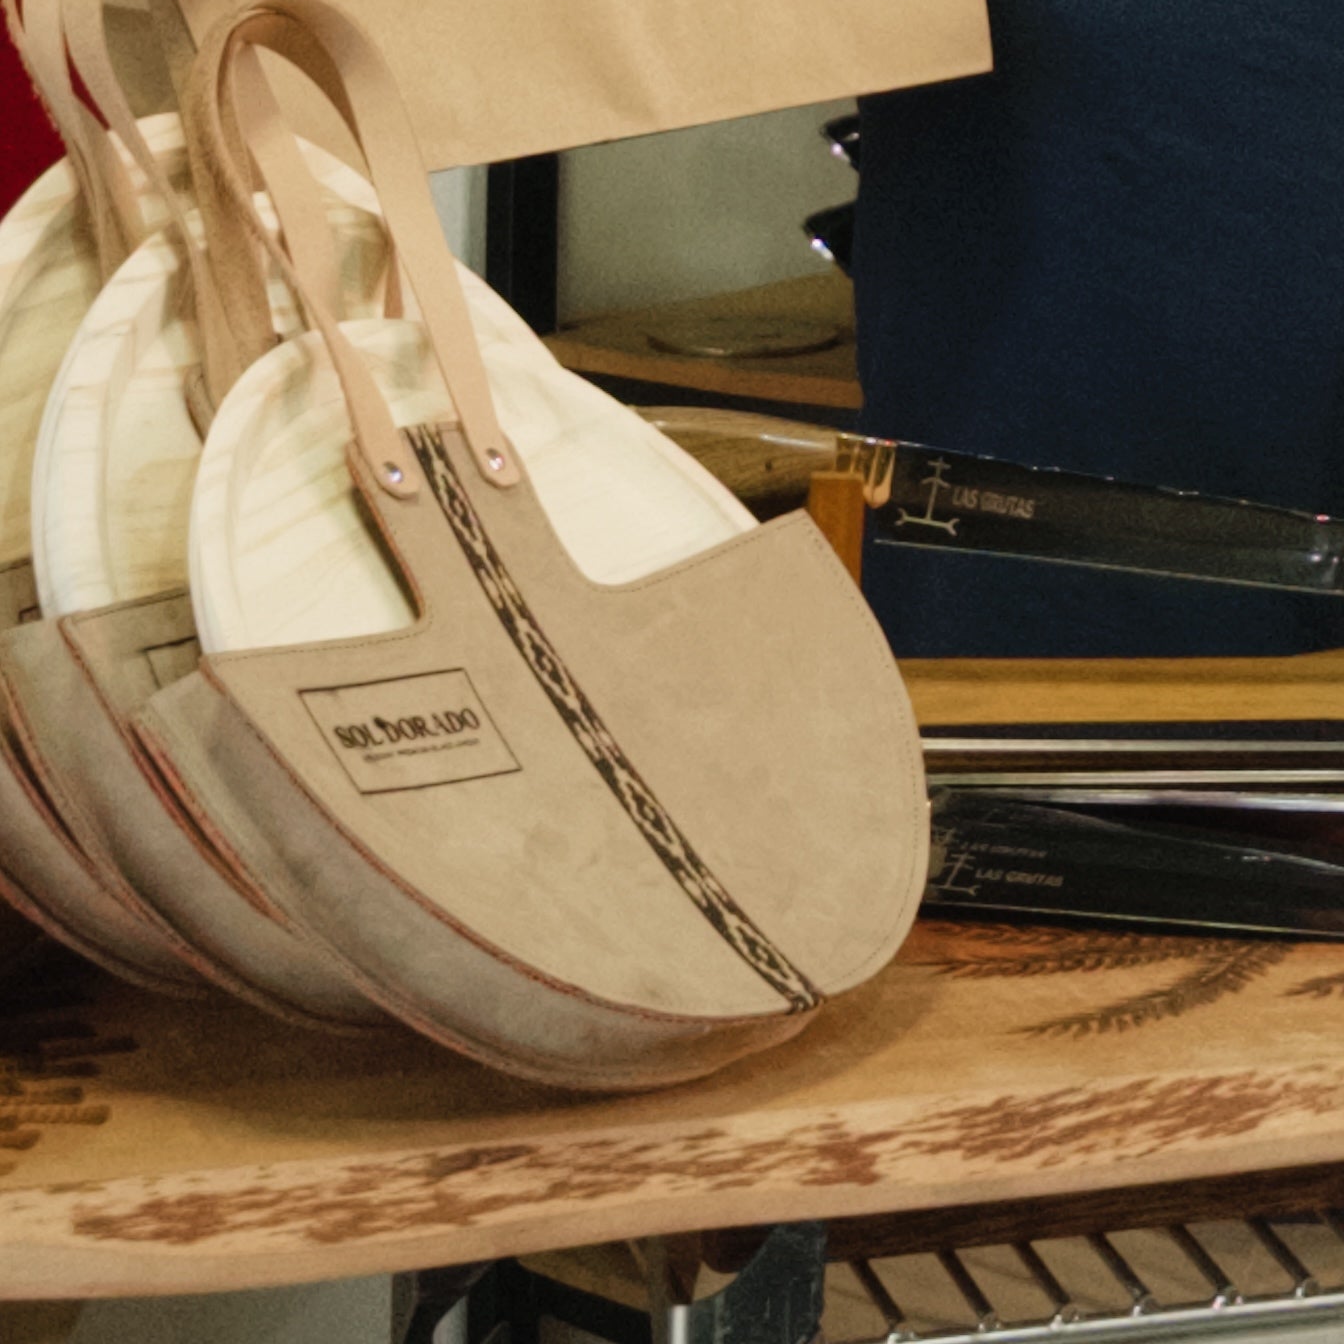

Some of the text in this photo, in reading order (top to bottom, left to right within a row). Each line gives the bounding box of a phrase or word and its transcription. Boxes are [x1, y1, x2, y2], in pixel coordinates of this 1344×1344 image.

[951, 485, 1036, 520] LAS GRUTAS
[334, 707, 480, 749] SOL DORADO
[974, 867, 1064, 888] LAS GRUTAS
